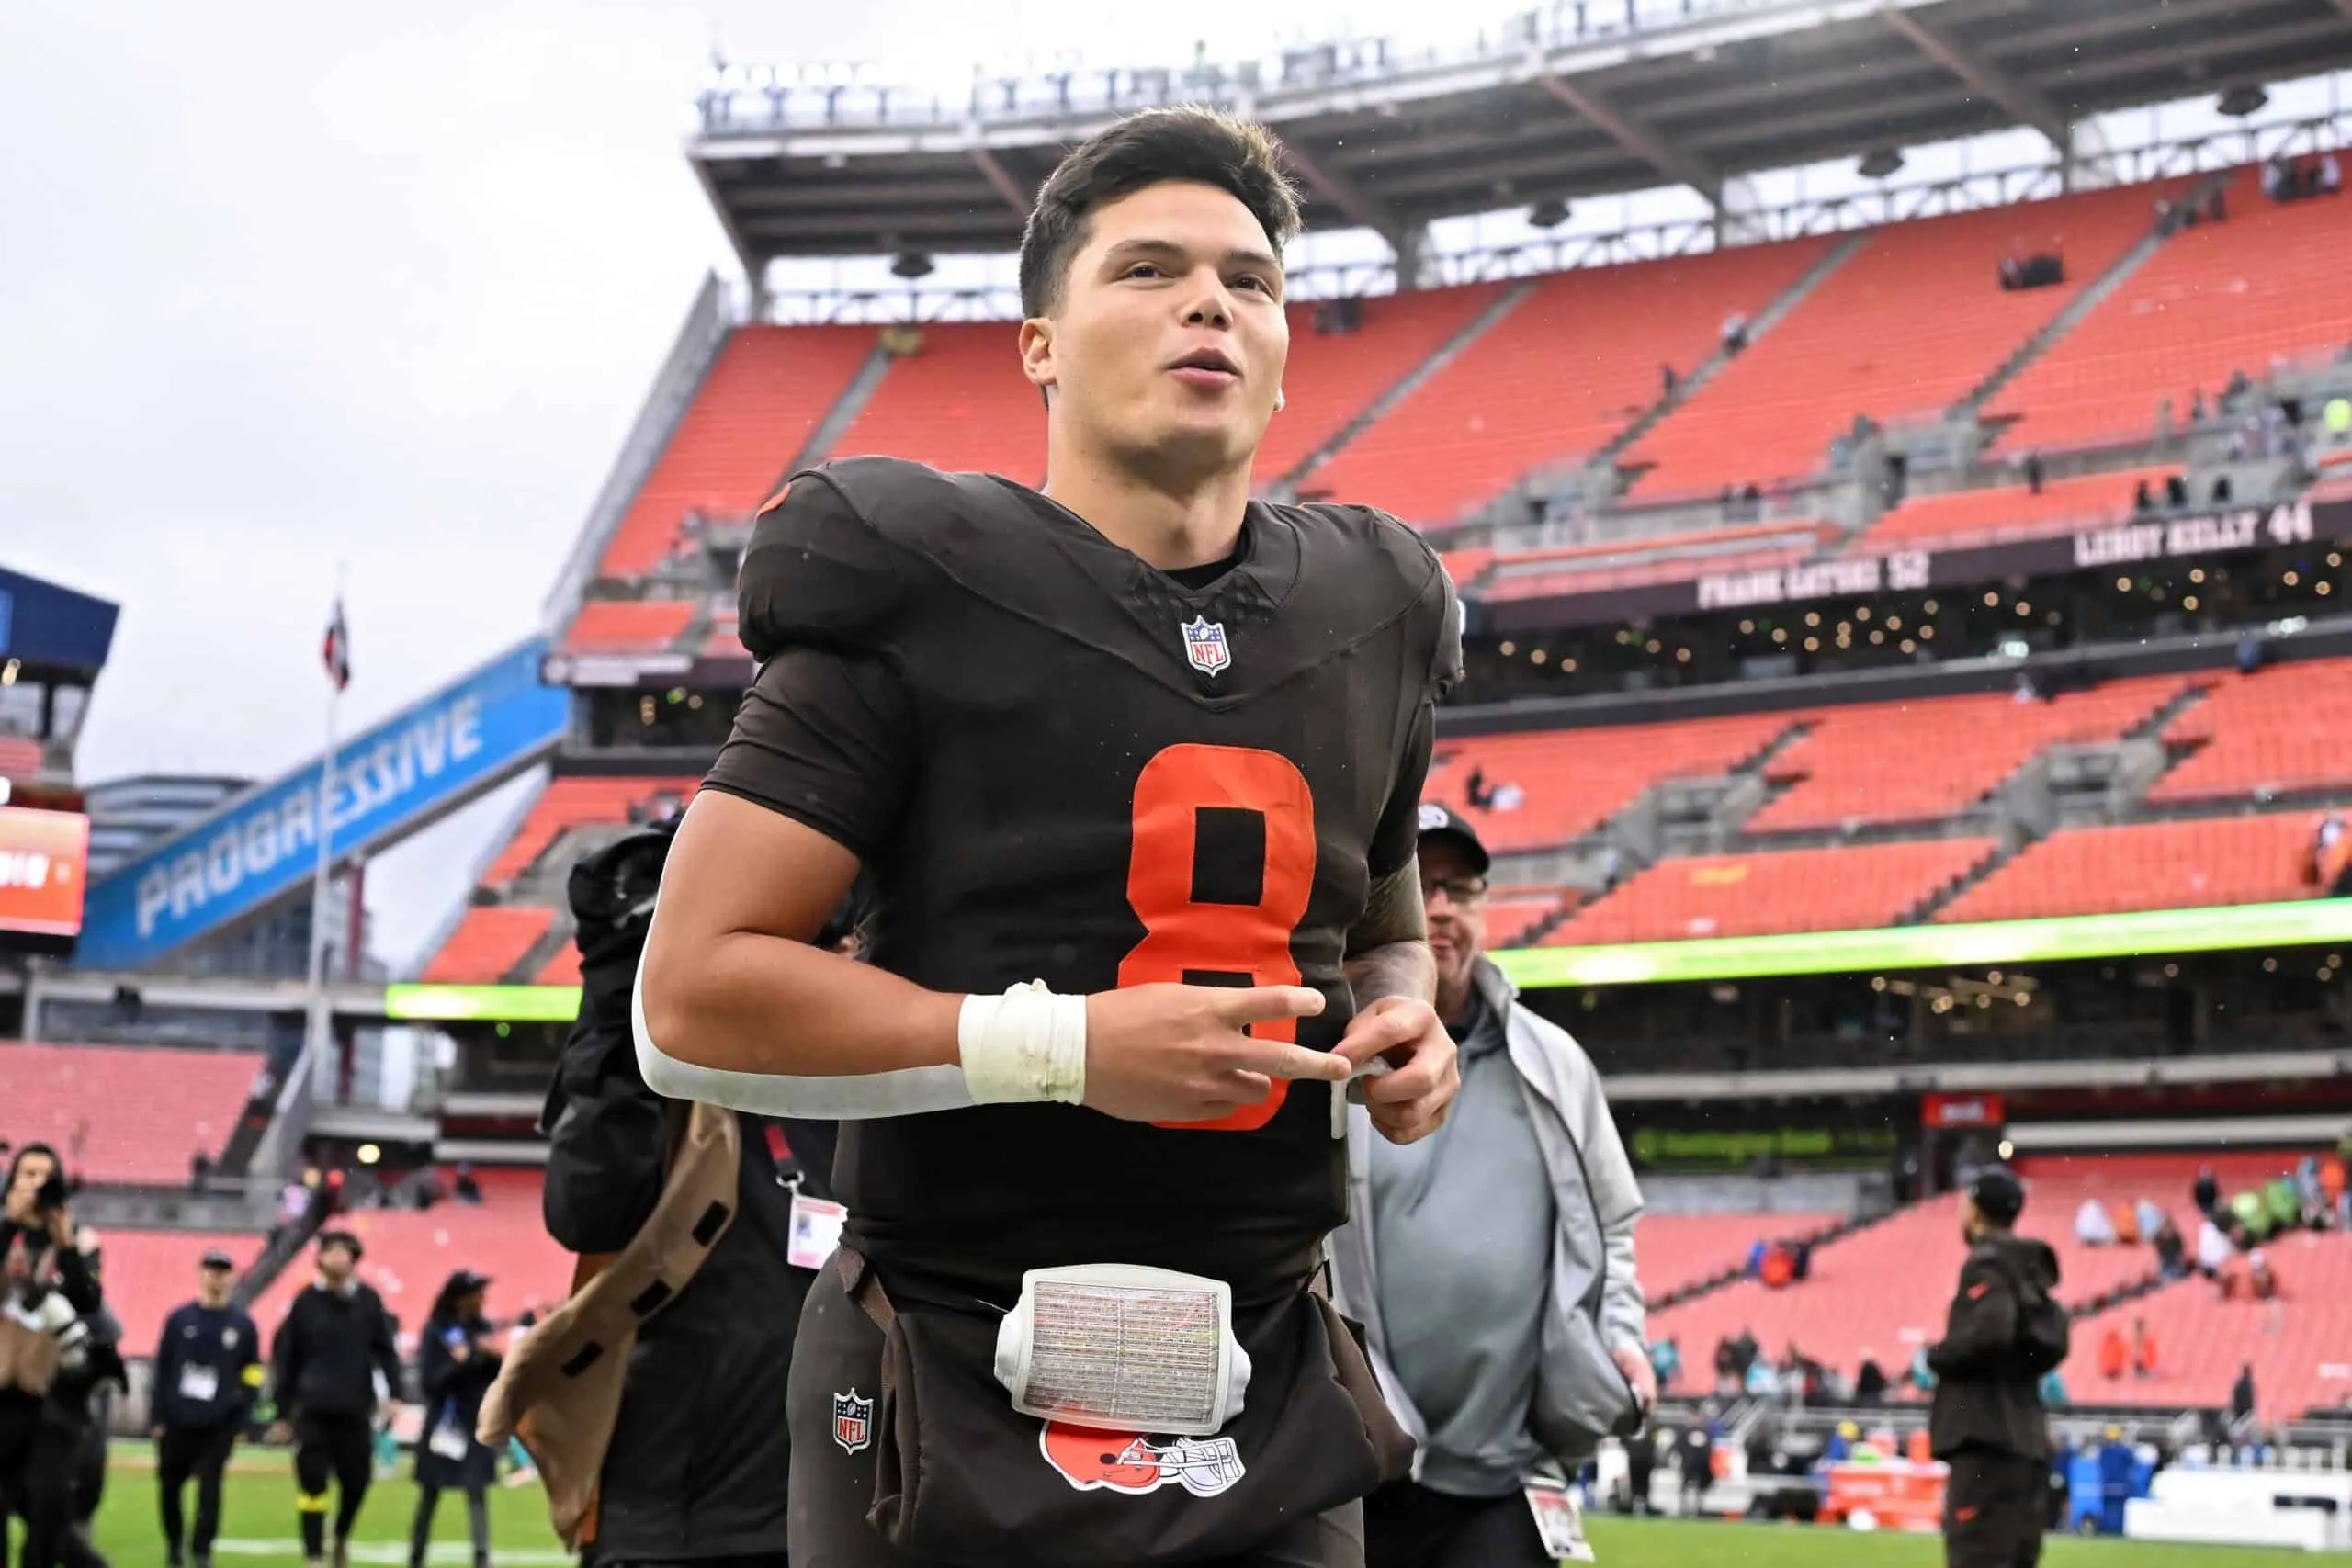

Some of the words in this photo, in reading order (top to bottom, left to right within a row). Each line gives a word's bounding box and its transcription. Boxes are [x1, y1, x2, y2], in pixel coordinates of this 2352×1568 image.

[2167, 512, 2257, 555] KELLY
[2267, 500, 2313, 544] 44
[1193, 643, 1224, 665] NFL
[137, 696, 482, 937] PROGRESSIVE
[1117, 743, 1317, 1130] 8
[839, 1417, 865, 1441] NFL
